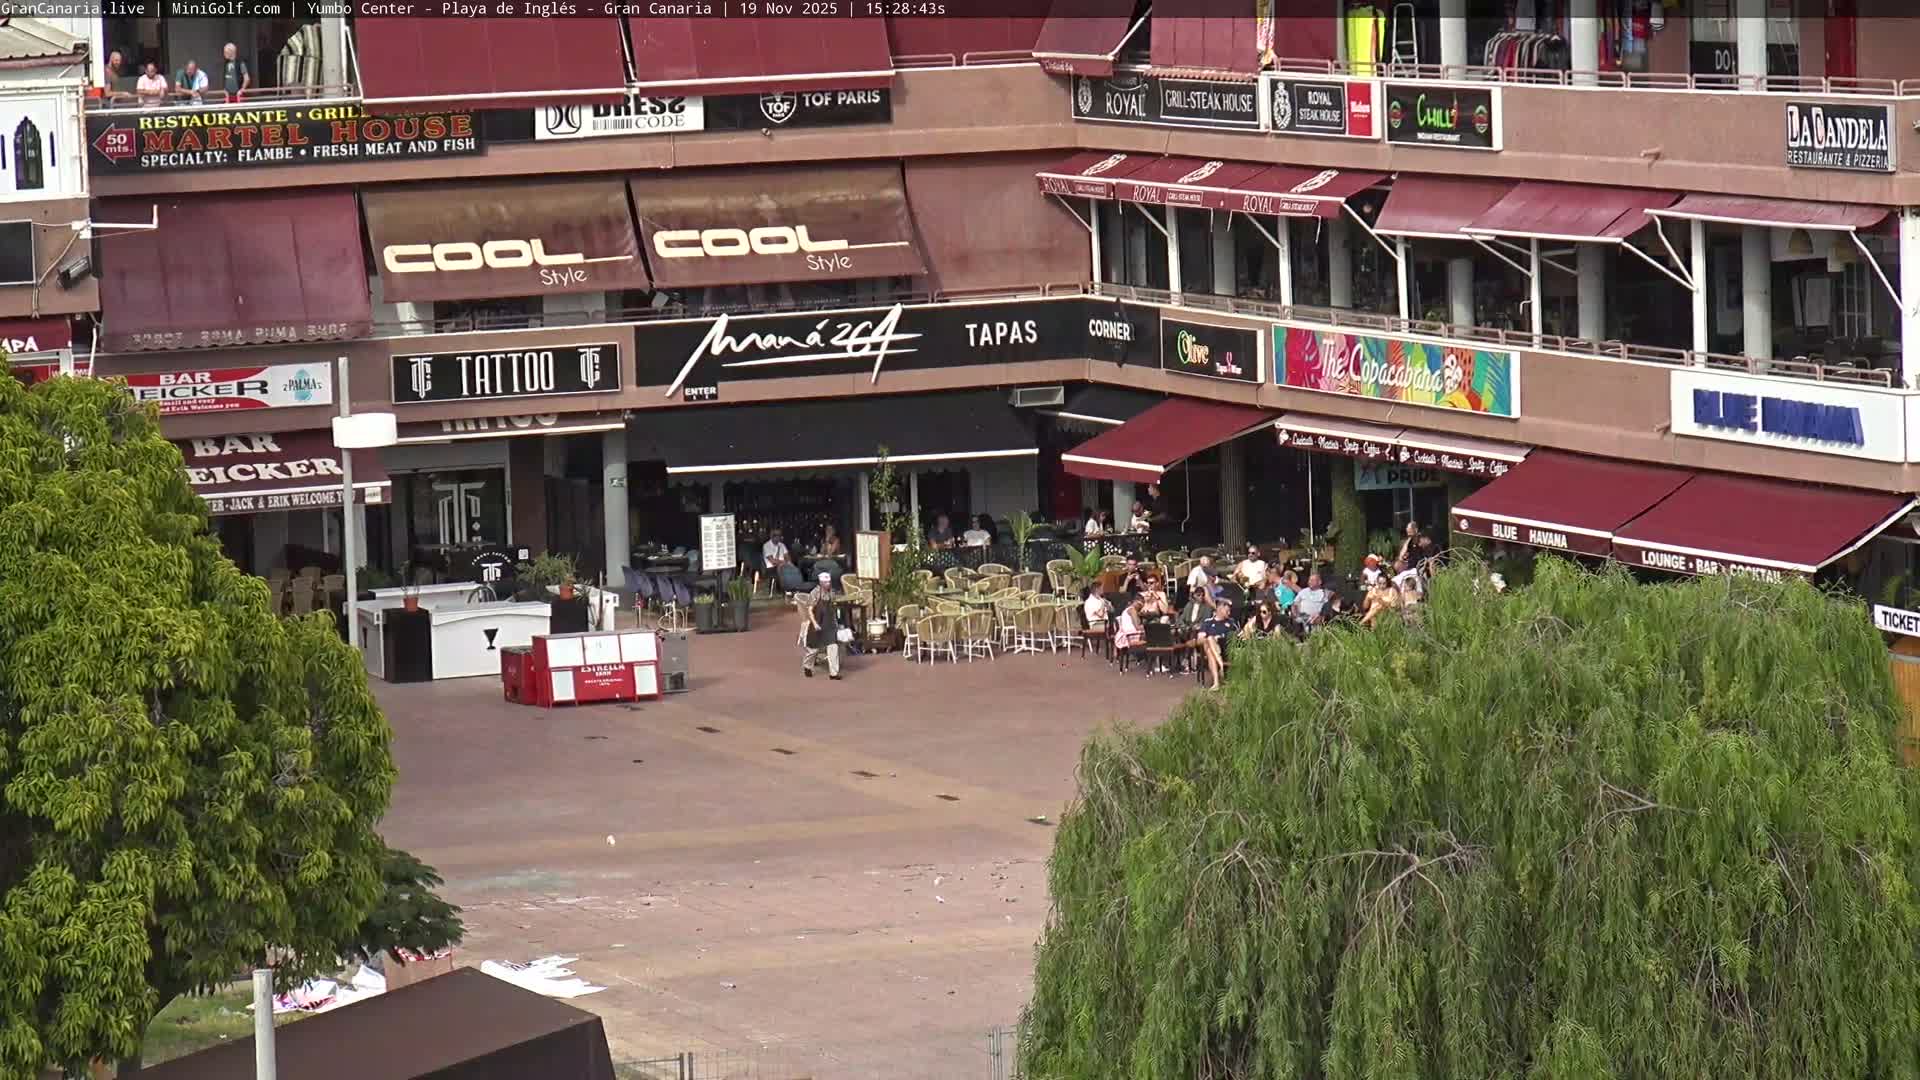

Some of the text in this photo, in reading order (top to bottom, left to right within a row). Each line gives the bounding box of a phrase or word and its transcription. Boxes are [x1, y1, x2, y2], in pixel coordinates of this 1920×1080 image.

[766, 101, 791, 114] TOF
[802, 90, 881, 107] TOF PARIS
[1106, 91, 1147, 117] ROYAL
[1222, 93, 1253, 112] HOUSE
[1307, 90, 1333, 106] ROYAL
[139, 109, 288, 130] RESTAURANTE
[635, 114, 686, 129] CODE
[106, 133, 128, 146] 50
[142, 115, 474, 153] MARTEL HOUSE
[141, 137, 476, 168] SPECIALTY: FLAMBE FRESH MEAT AND FISH
[1787, 150, 1843, 167] RESTAURANTE
[1853, 153, 1889, 169] PIZZERIA
[1133, 185, 1161, 203] ROYAL
[1243, 195, 1273, 213] ROYAL
[652, 225, 849, 259] COOL
[383, 237, 585, 274] COOL
[806, 252, 853, 272] Style
[539, 266, 588, 287] Style
[965, 319, 1039, 347] TAPAS
[1088, 318, 1131, 342] CORNER
[455, 351, 557, 397] TATTOO
[1320, 338, 1444, 393] The Copacabana
[160, 371, 212, 386] BAR
[684, 386, 717, 396] ENTER
[192, 433, 281, 457] BAR
[186, 457, 343, 485] EICKER
[230, 497, 253, 511] JACK
[268, 495, 290, 508] ERIK
[291, 491, 336, 505] WELCOME
[336, 490, 356, 503] YU
[1492, 523, 1568, 549] BLUE HAVANA
[1642, 550, 1687, 571] LOUNGE
[1695, 558, 1719, 576] BAR
